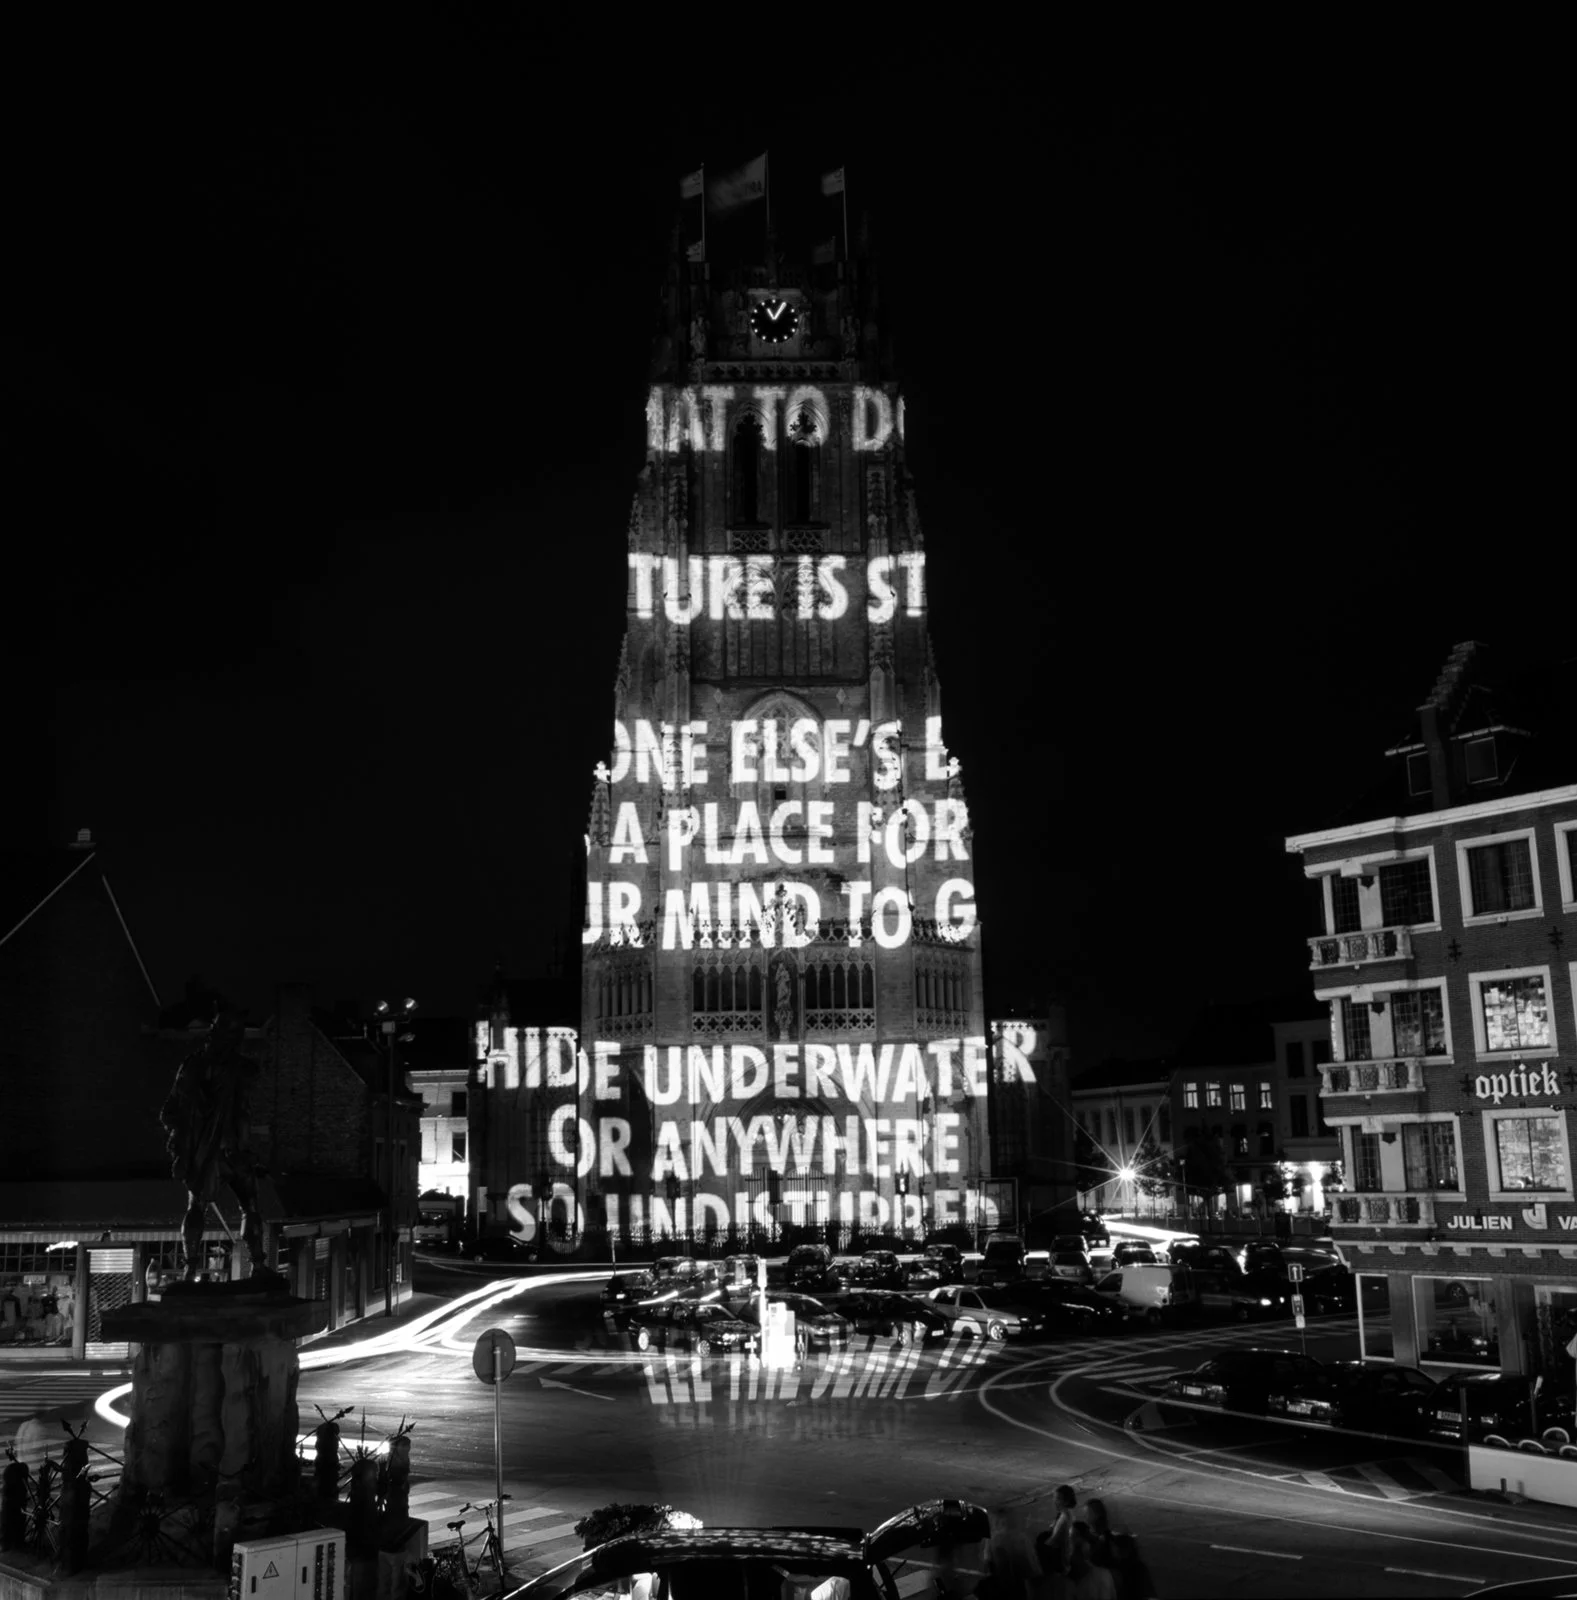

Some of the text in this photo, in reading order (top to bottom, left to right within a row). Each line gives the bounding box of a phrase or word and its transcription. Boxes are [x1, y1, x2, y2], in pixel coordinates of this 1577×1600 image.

[752, 384, 830, 451] TO
[628, 551, 926, 625] TURE IS ST
[731, 718, 902, 790] ELSE'S
[608, 798, 971, 872] A PLACE FOR
[661, 881, 821, 950] MIND
[840, 880, 914, 949] TO
[476, 1020, 1038, 1106] HIDE UNDERWATER
[1475, 1062, 1560, 1105] optiek
[548, 1103, 960, 1182] OR ANYWHERE
[506, 1183, 585, 1255] SO
[1447, 1215, 1513, 1231] JULIEN
